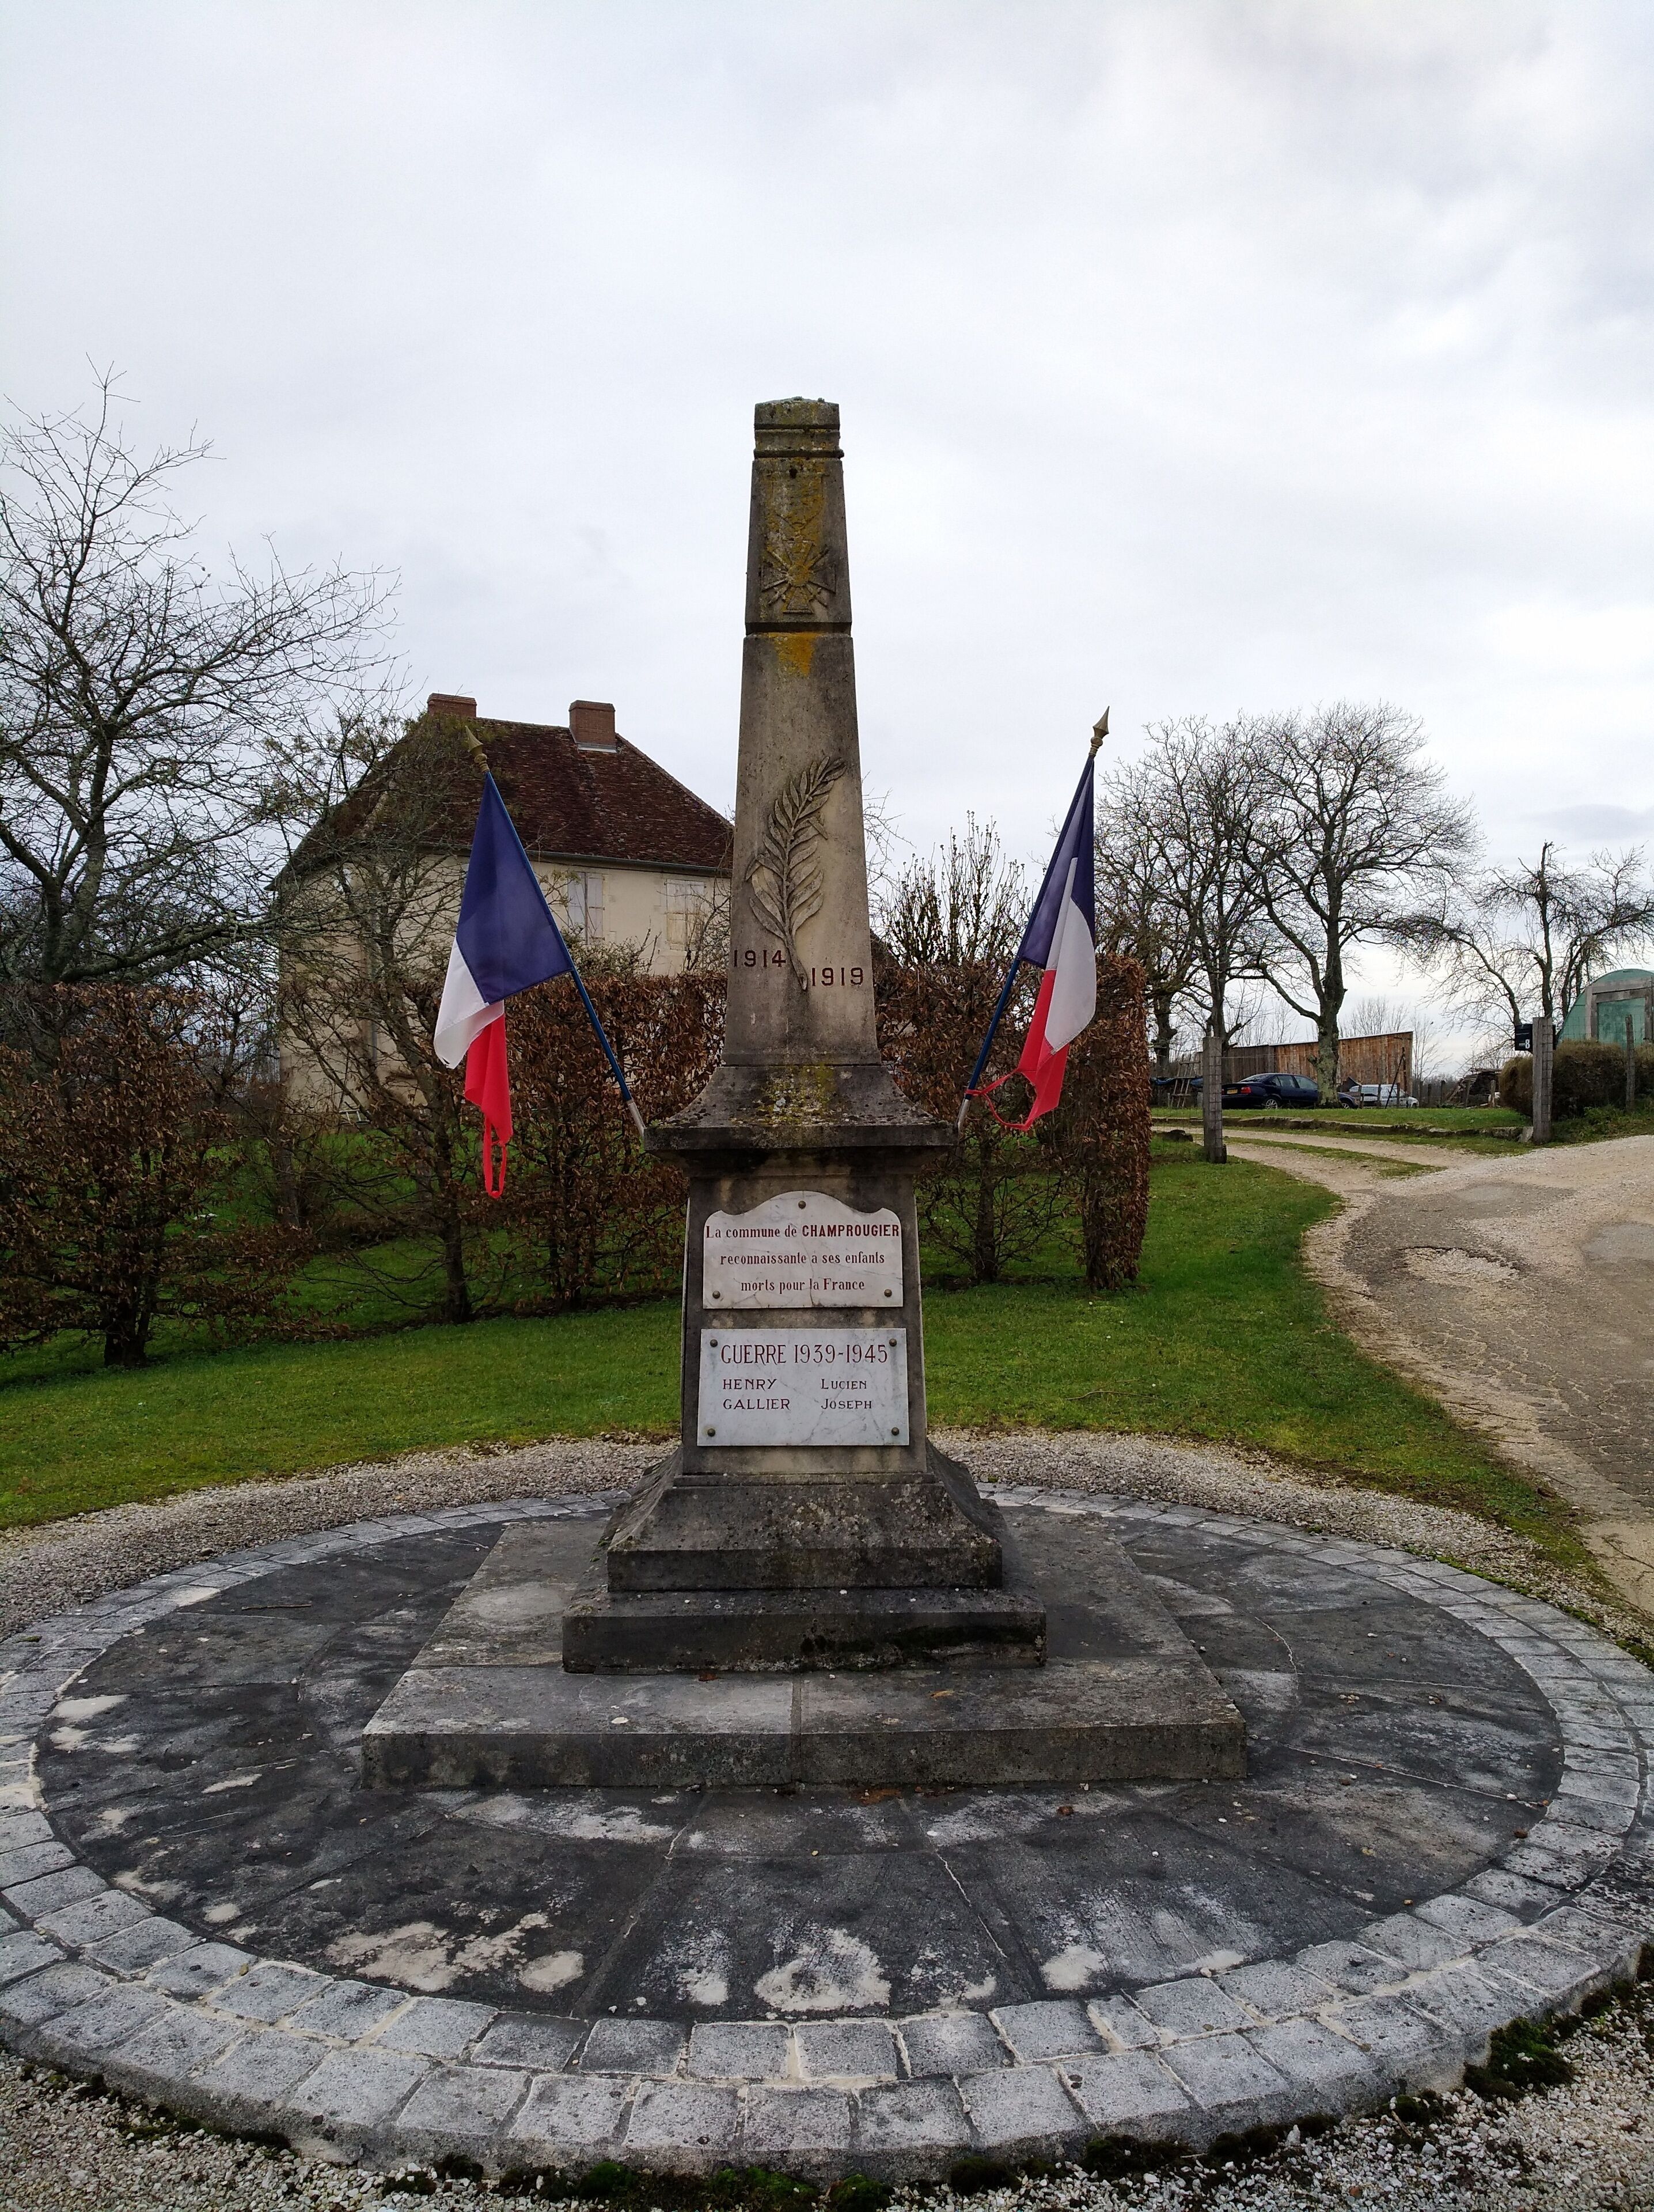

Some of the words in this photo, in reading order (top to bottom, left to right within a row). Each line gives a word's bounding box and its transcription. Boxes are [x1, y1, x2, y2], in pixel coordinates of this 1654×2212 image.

[734, 950, 786, 968] 1914
[811, 967, 864, 986] 1919
[1525, 1039, 1530, 1049] 8
[706, 1225, 721, 1238] La
[726, 1228, 780, 1238] commune
[784, 1225, 797, 1237] de
[802, 1224, 900, 1237] CHAMPROUGIER
[720, 1252, 806, 1265] reconnaissante
[822, 1254, 840, 1264] ses
[845, 1251, 885, 1264] enfants
[741, 1279, 775, 1291] morts
[779, 1281, 805, 1294] pour
[809, 1278, 820, 1290] la
[823, 1278, 865, 1290] France
[721, 1344, 787, 1365] GUERRE
[794, 1344, 889, 1364] 1939-1945
[723, 1378, 777, 1391] HENRY
[723, 1399, 790, 1411] GALLIER
